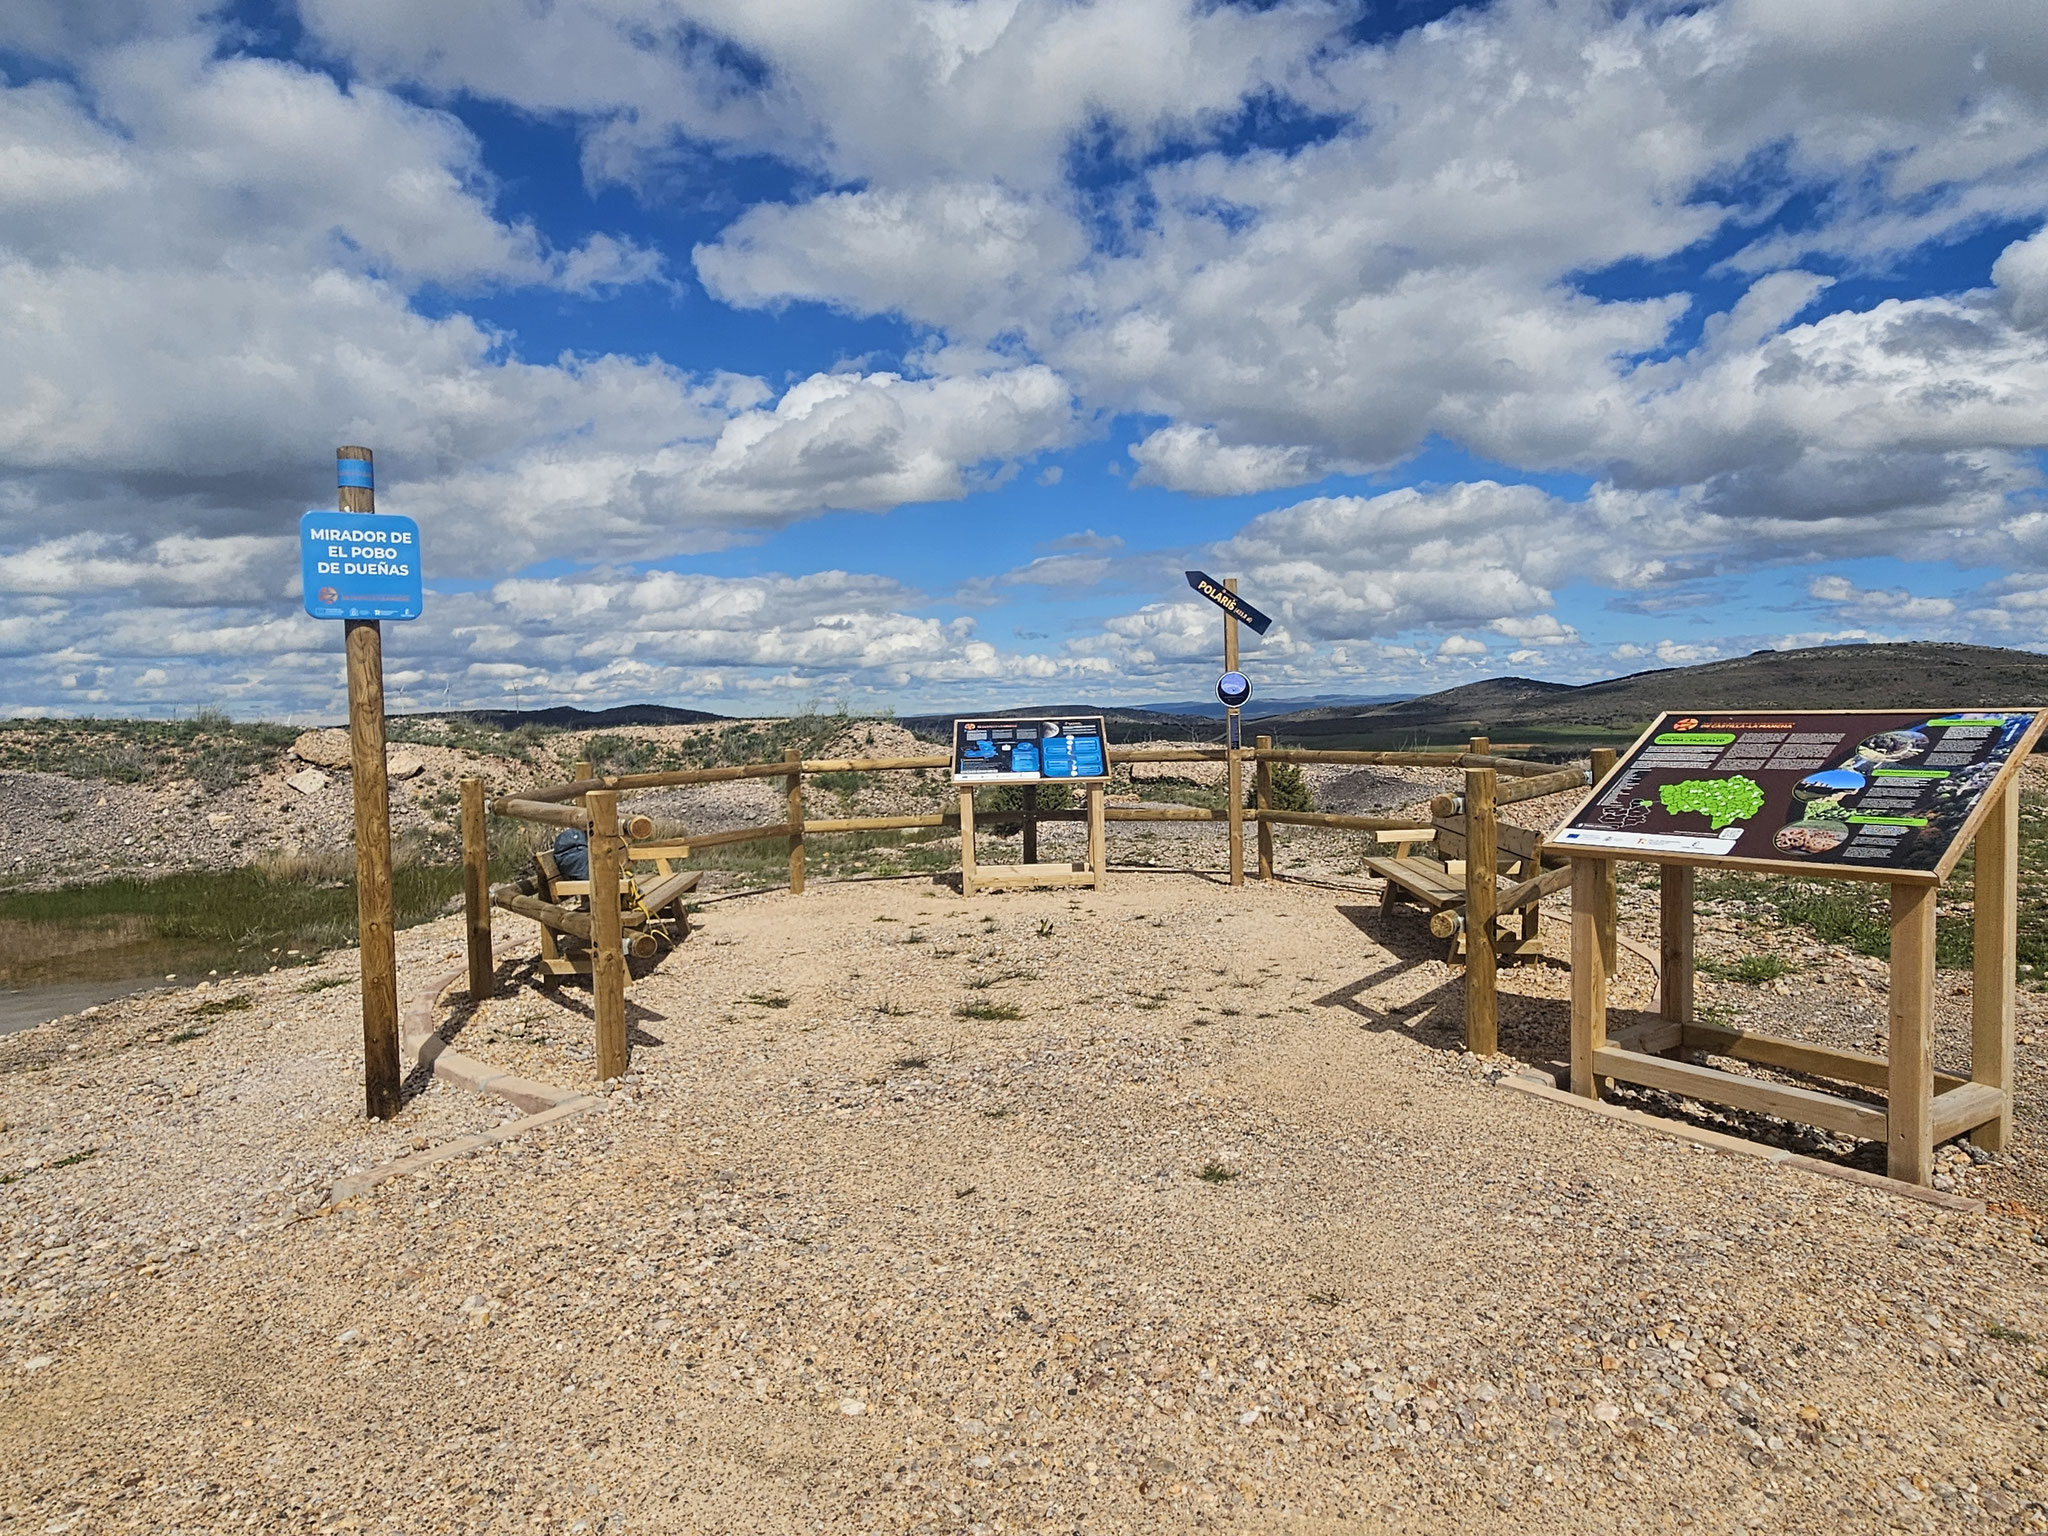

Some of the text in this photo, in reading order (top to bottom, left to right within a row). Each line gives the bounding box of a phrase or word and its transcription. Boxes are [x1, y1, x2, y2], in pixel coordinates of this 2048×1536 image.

[310, 528, 412, 544] MIRADOR DE
[328, 546, 397, 559] EL POBO
[317, 561, 409, 576] DE DUEÑAS
[1198, 581, 1237, 611] POLARIS
